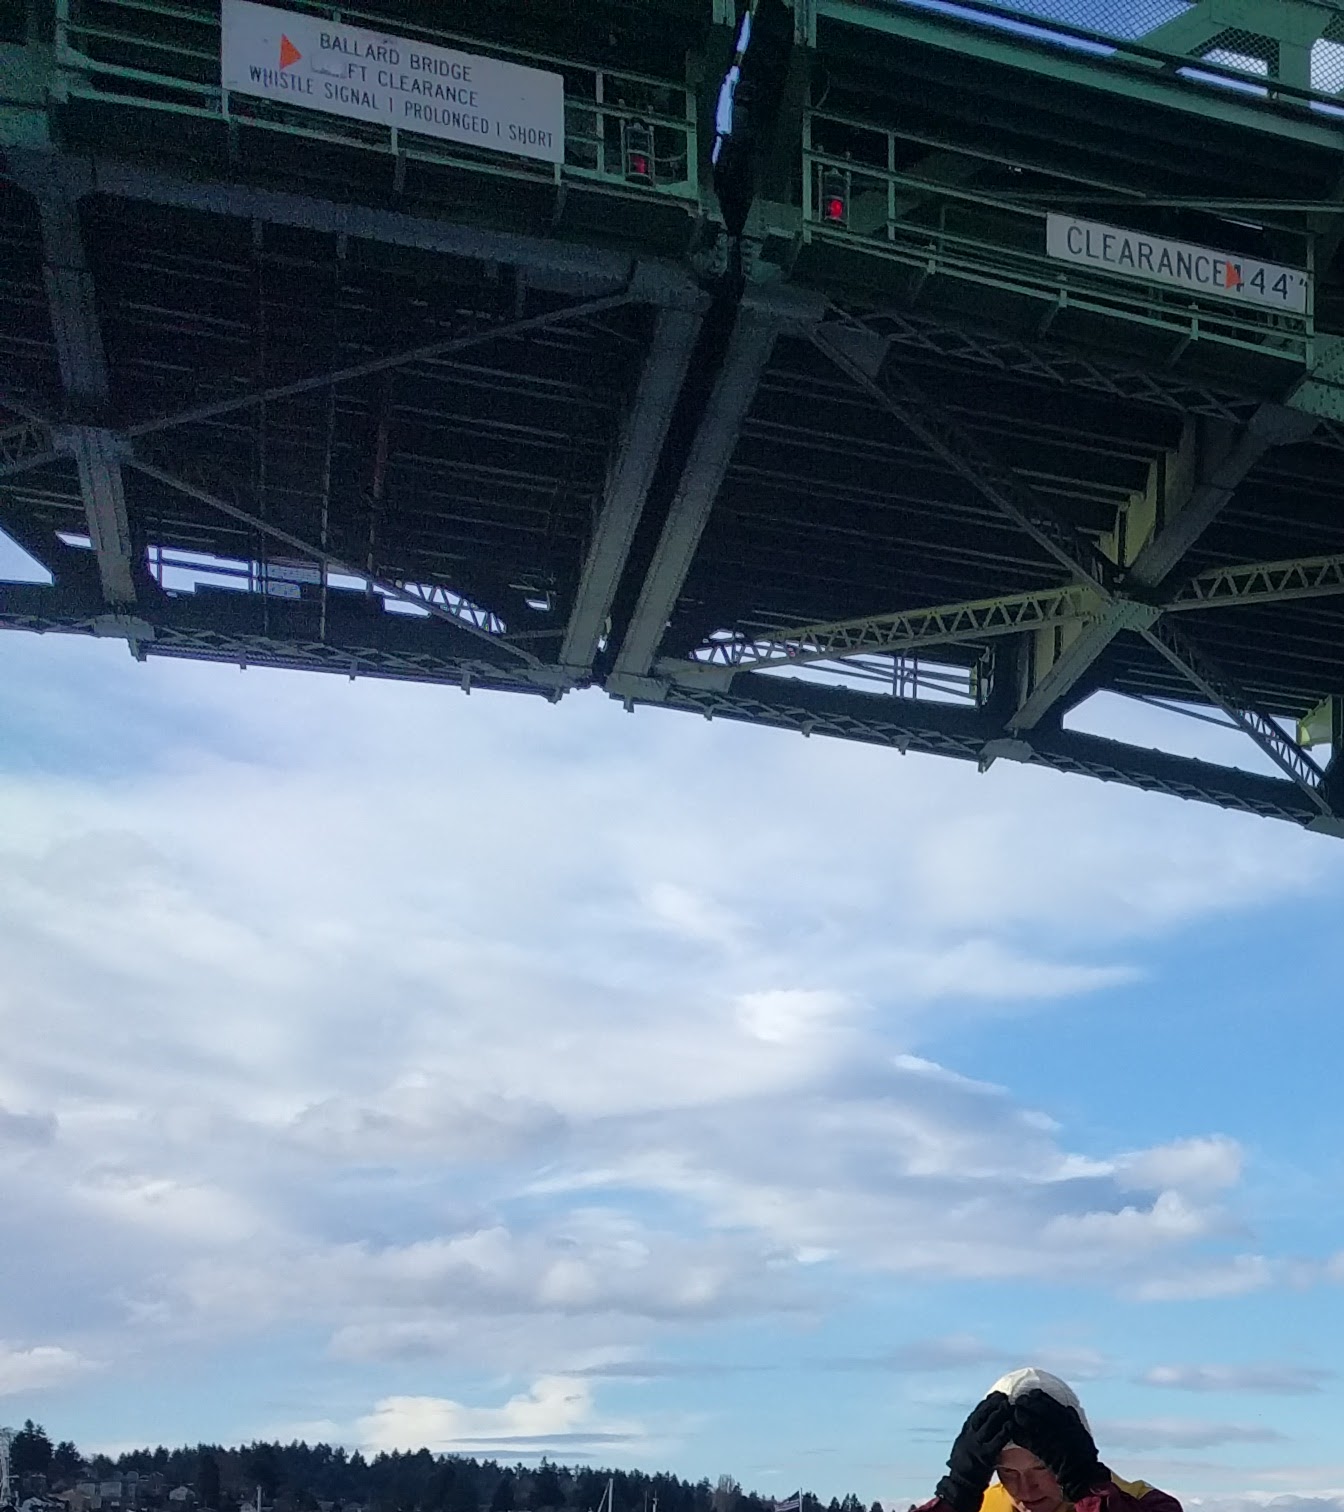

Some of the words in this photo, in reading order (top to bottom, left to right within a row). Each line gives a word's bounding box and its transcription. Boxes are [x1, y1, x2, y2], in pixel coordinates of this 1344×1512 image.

[319, 32, 400, 66] BALLARD
[410, 53, 473, 83] BRIDGE
[348, 63, 368, 82] FT
[377, 70, 479, 108] CLEARANCE
[249, 64, 315, 95] WHISTLE
[324, 81, 380, 110] SIGNAL
[404, 100, 490, 135] PROLONGED
[508, 123, 554, 148] SHORT
[1066, 225, 1227, 288] CLEARANCE
